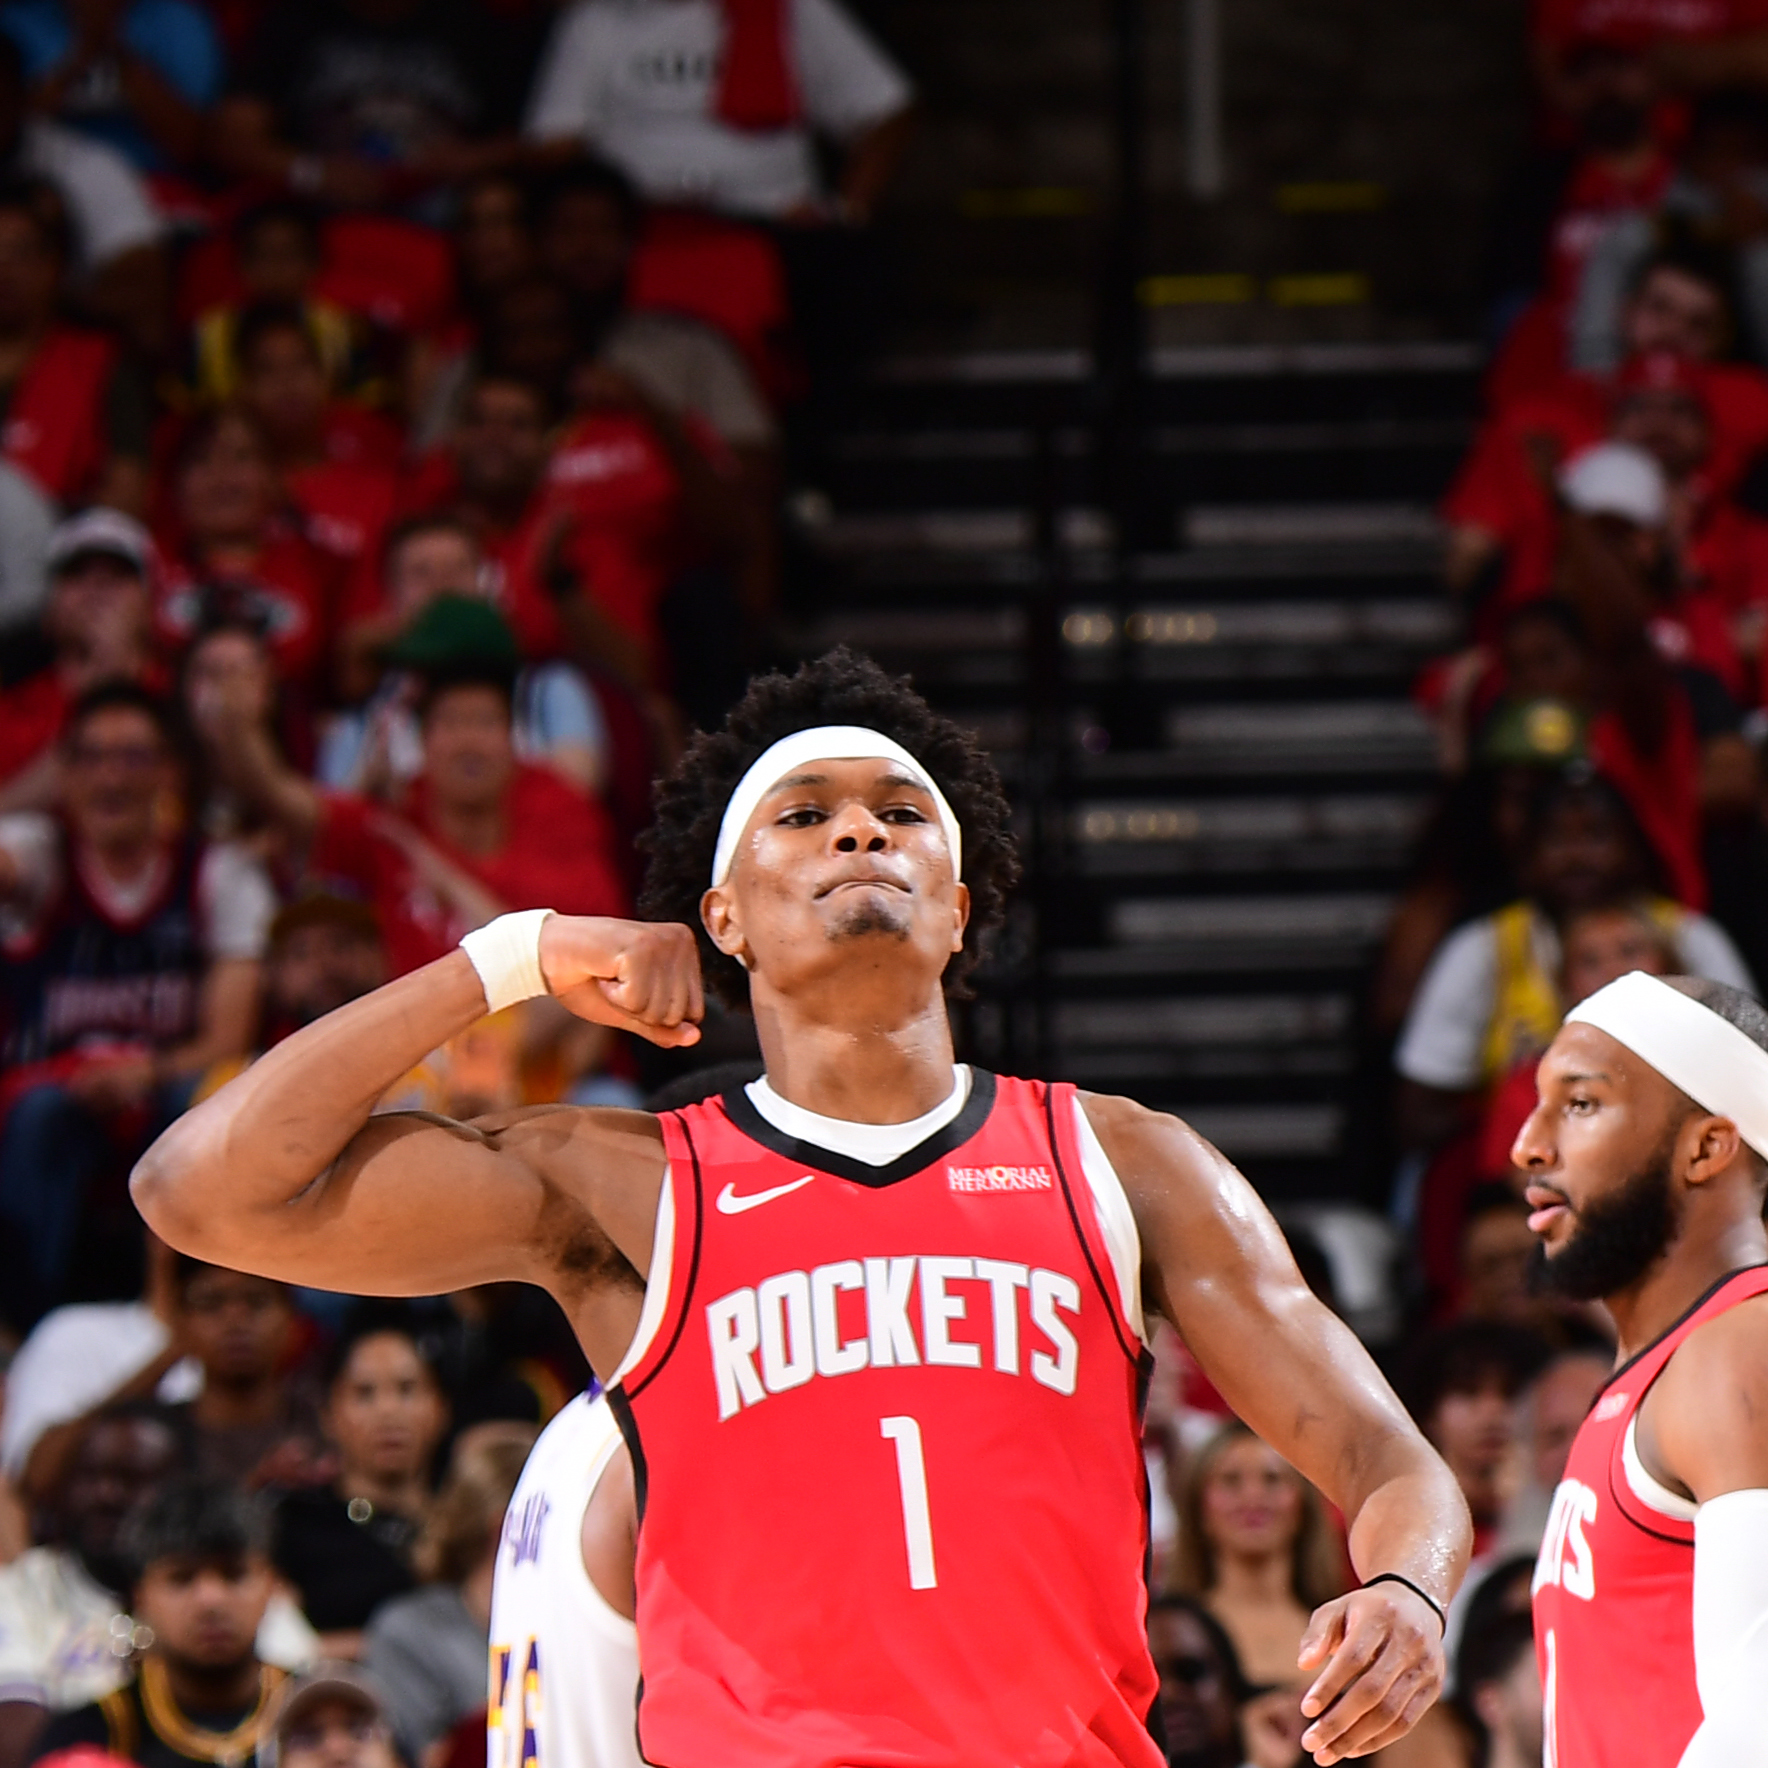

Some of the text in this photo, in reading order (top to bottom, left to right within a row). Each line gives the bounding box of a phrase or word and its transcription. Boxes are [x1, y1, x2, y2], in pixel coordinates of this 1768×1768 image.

[947, 1165, 1050, 1181] MEMORIAL
[949, 1174, 1052, 1192] HERMANN
[705, 1254, 1082, 1423] ROCKETS
[879, 1415, 939, 1591] 1
